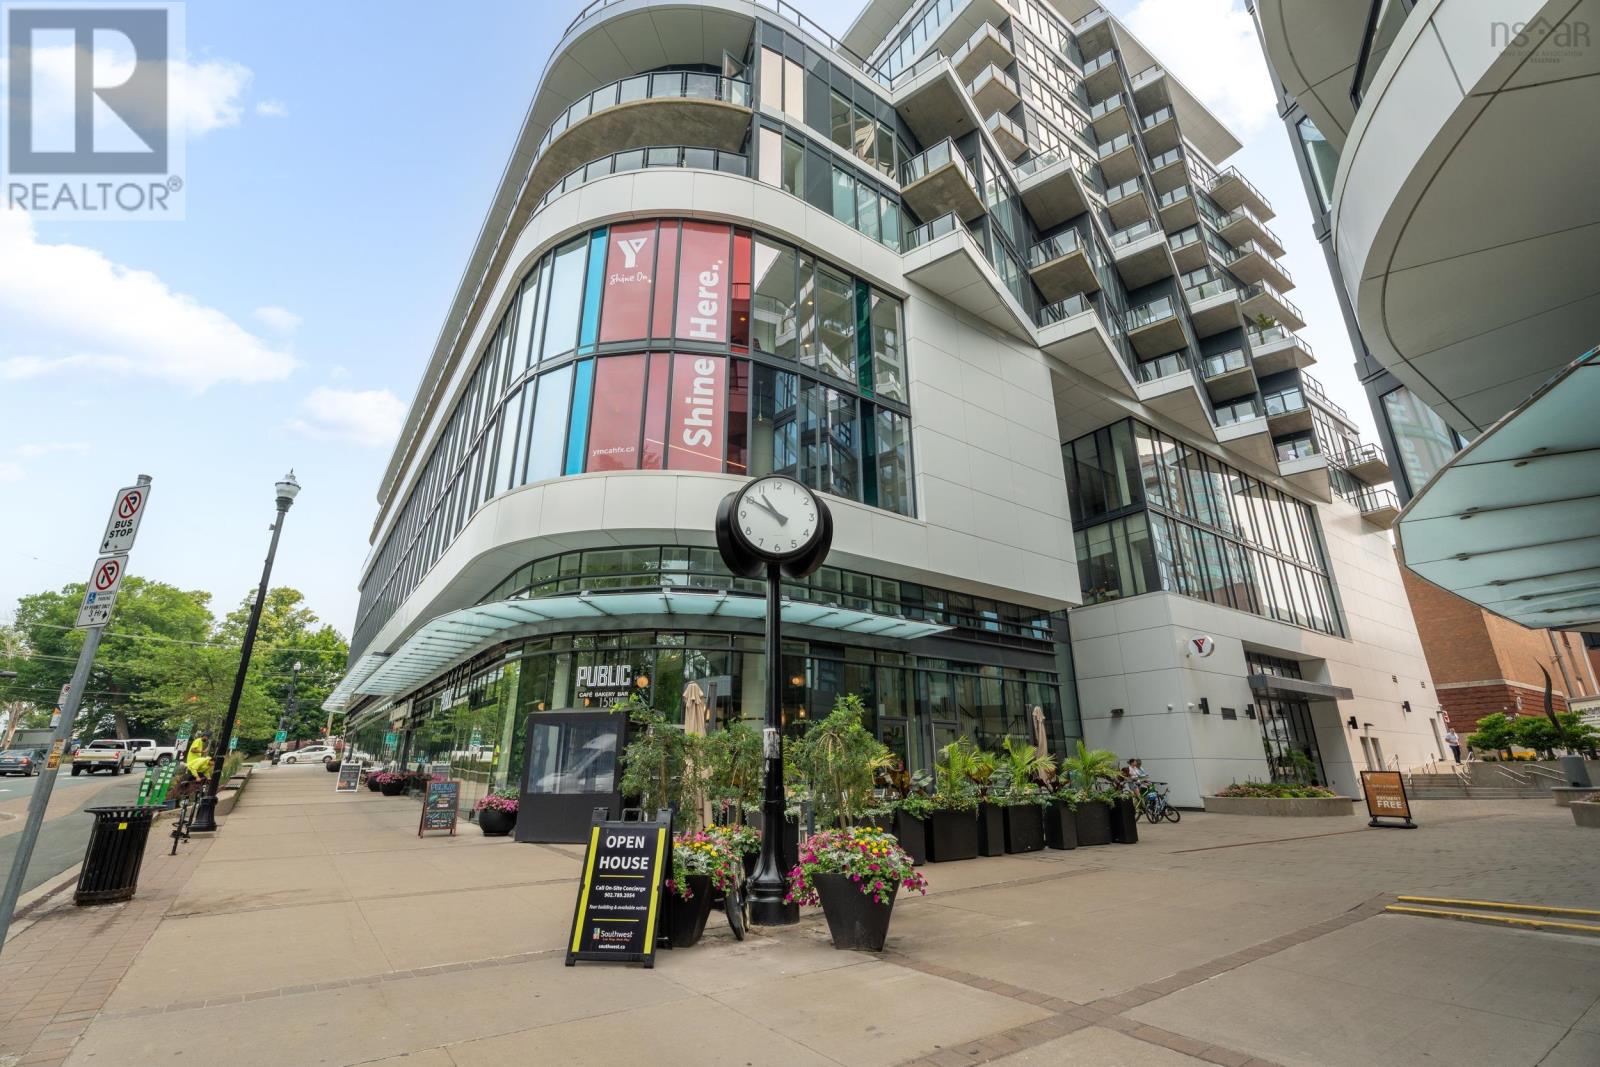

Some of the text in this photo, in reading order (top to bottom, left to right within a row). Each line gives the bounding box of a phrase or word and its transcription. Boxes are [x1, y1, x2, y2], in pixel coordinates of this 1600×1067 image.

[610, 273, 635, 286] Shine
[682, 358, 716, 448] Shine
[758, 485, 765, 494] 11
[773, 481, 782, 490] 12
[803, 497, 809, 506] 2
[740, 510, 747, 519] 9
[808, 513, 815, 522] 3
[114, 519, 133, 529] BUS
[109, 528, 133, 539] STOP
[745, 526, 752, 536] 8
[803, 528, 809, 537] 4
[758, 538, 764, 547] 7
[791, 539, 798, 549] 5
[774, 543, 781, 553] 6
[576, 664, 631, 687] PUBLIC
[1376, 800, 1403, 808] FREE
[606, 835, 645, 849] OPEN
[599, 856, 650, 870] HOUSE
[623, 885, 646, 893] Concierge
[600, 930, 633, 938] Southwest
